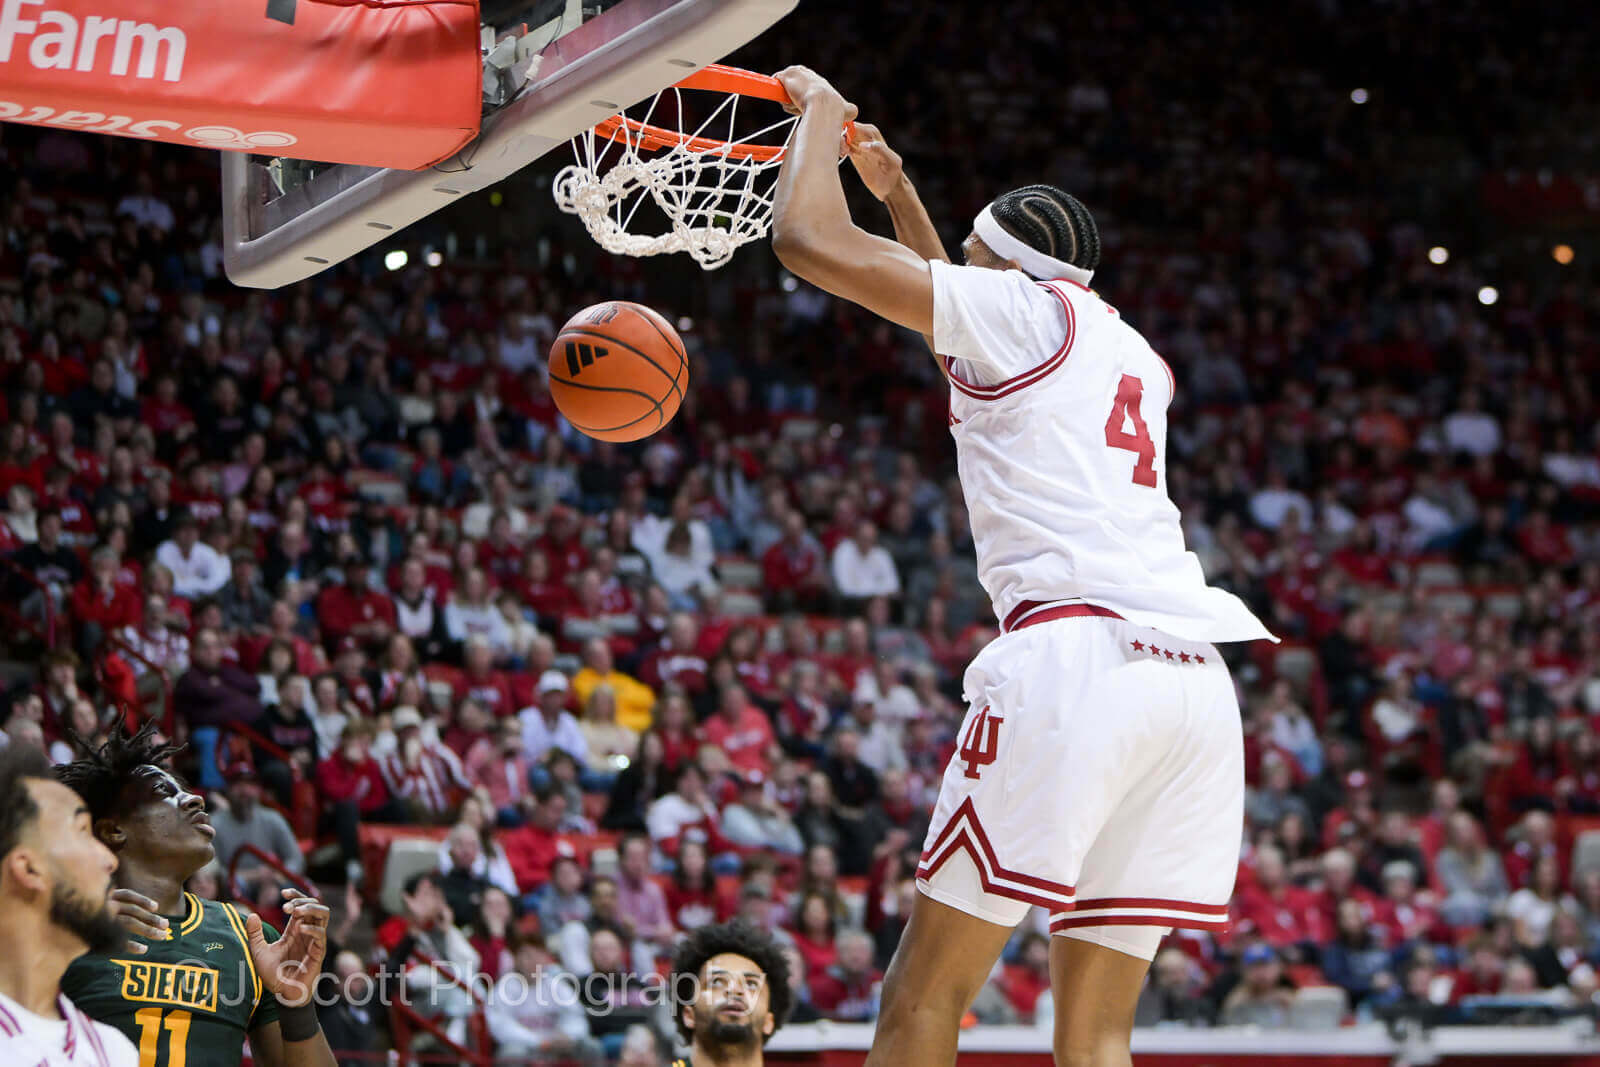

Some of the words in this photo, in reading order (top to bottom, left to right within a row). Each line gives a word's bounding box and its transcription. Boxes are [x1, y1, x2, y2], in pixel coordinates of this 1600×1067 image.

[0, 0, 187, 82] Farm
[1104, 373, 1157, 489] 4
[126, 963, 215, 1009] SIENA
[135, 1007, 192, 1067] 11
